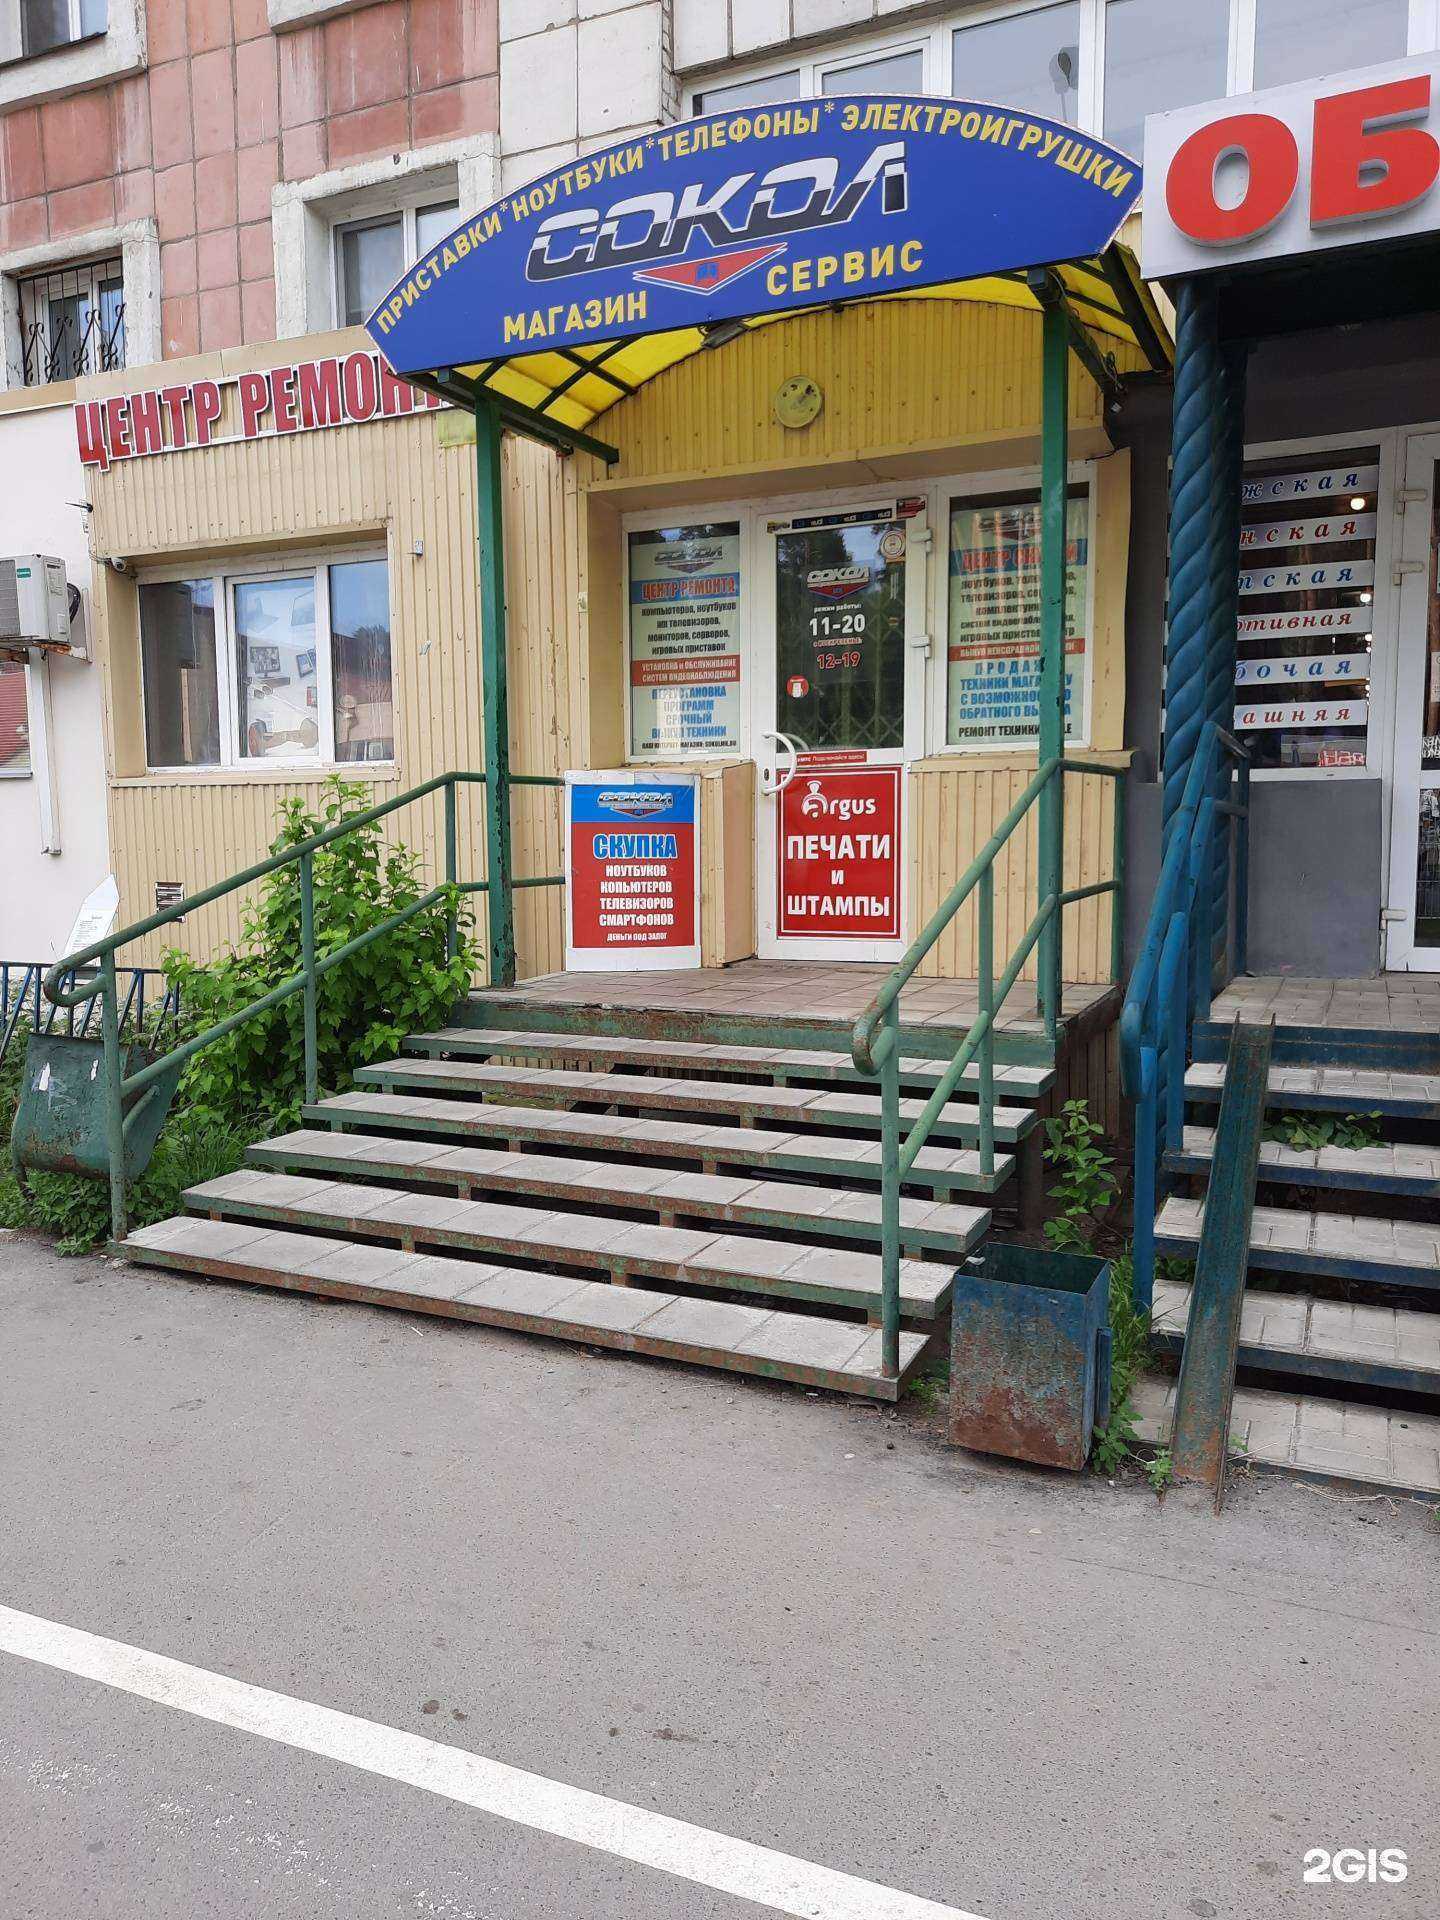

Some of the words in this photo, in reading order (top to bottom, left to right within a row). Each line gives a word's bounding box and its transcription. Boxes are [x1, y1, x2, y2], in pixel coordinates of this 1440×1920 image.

[1165, 74, 1440, 248] ОБ
[376, 211, 502, 335] ПРИСТАВКИ
[511, 145, 644, 222] НОУТБУКИ
[657, 107, 820, 162] ТЕЛЕФОНЫ
[840, 103, 1134, 198] ЭЛЕКТРОИГРУШКИ
[525, 141, 909, 284] СОКОЛ
[503, 290, 648, 344] МАГАЗИН
[766, 240, 924, 297] СЕРВИС
[73, 378, 222, 473] ЦЕНТР
[237, 350, 442, 440] РЕМОН
[809, 613, 866, 636] 11-20
[817, 650, 861, 670] 12-19
[592, 833, 678, 860] СКУПКА
[787, 834, 890, 861] ПЕЧАТИ
[605, 864, 667, 878] НОУТБУКОВ
[599, 897, 674, 911] ТЕЛЕВИЗОРОВ
[787, 895, 890, 918] ШТАМПЫ
[598, 913, 674, 927] СМАРТФОНОВ
